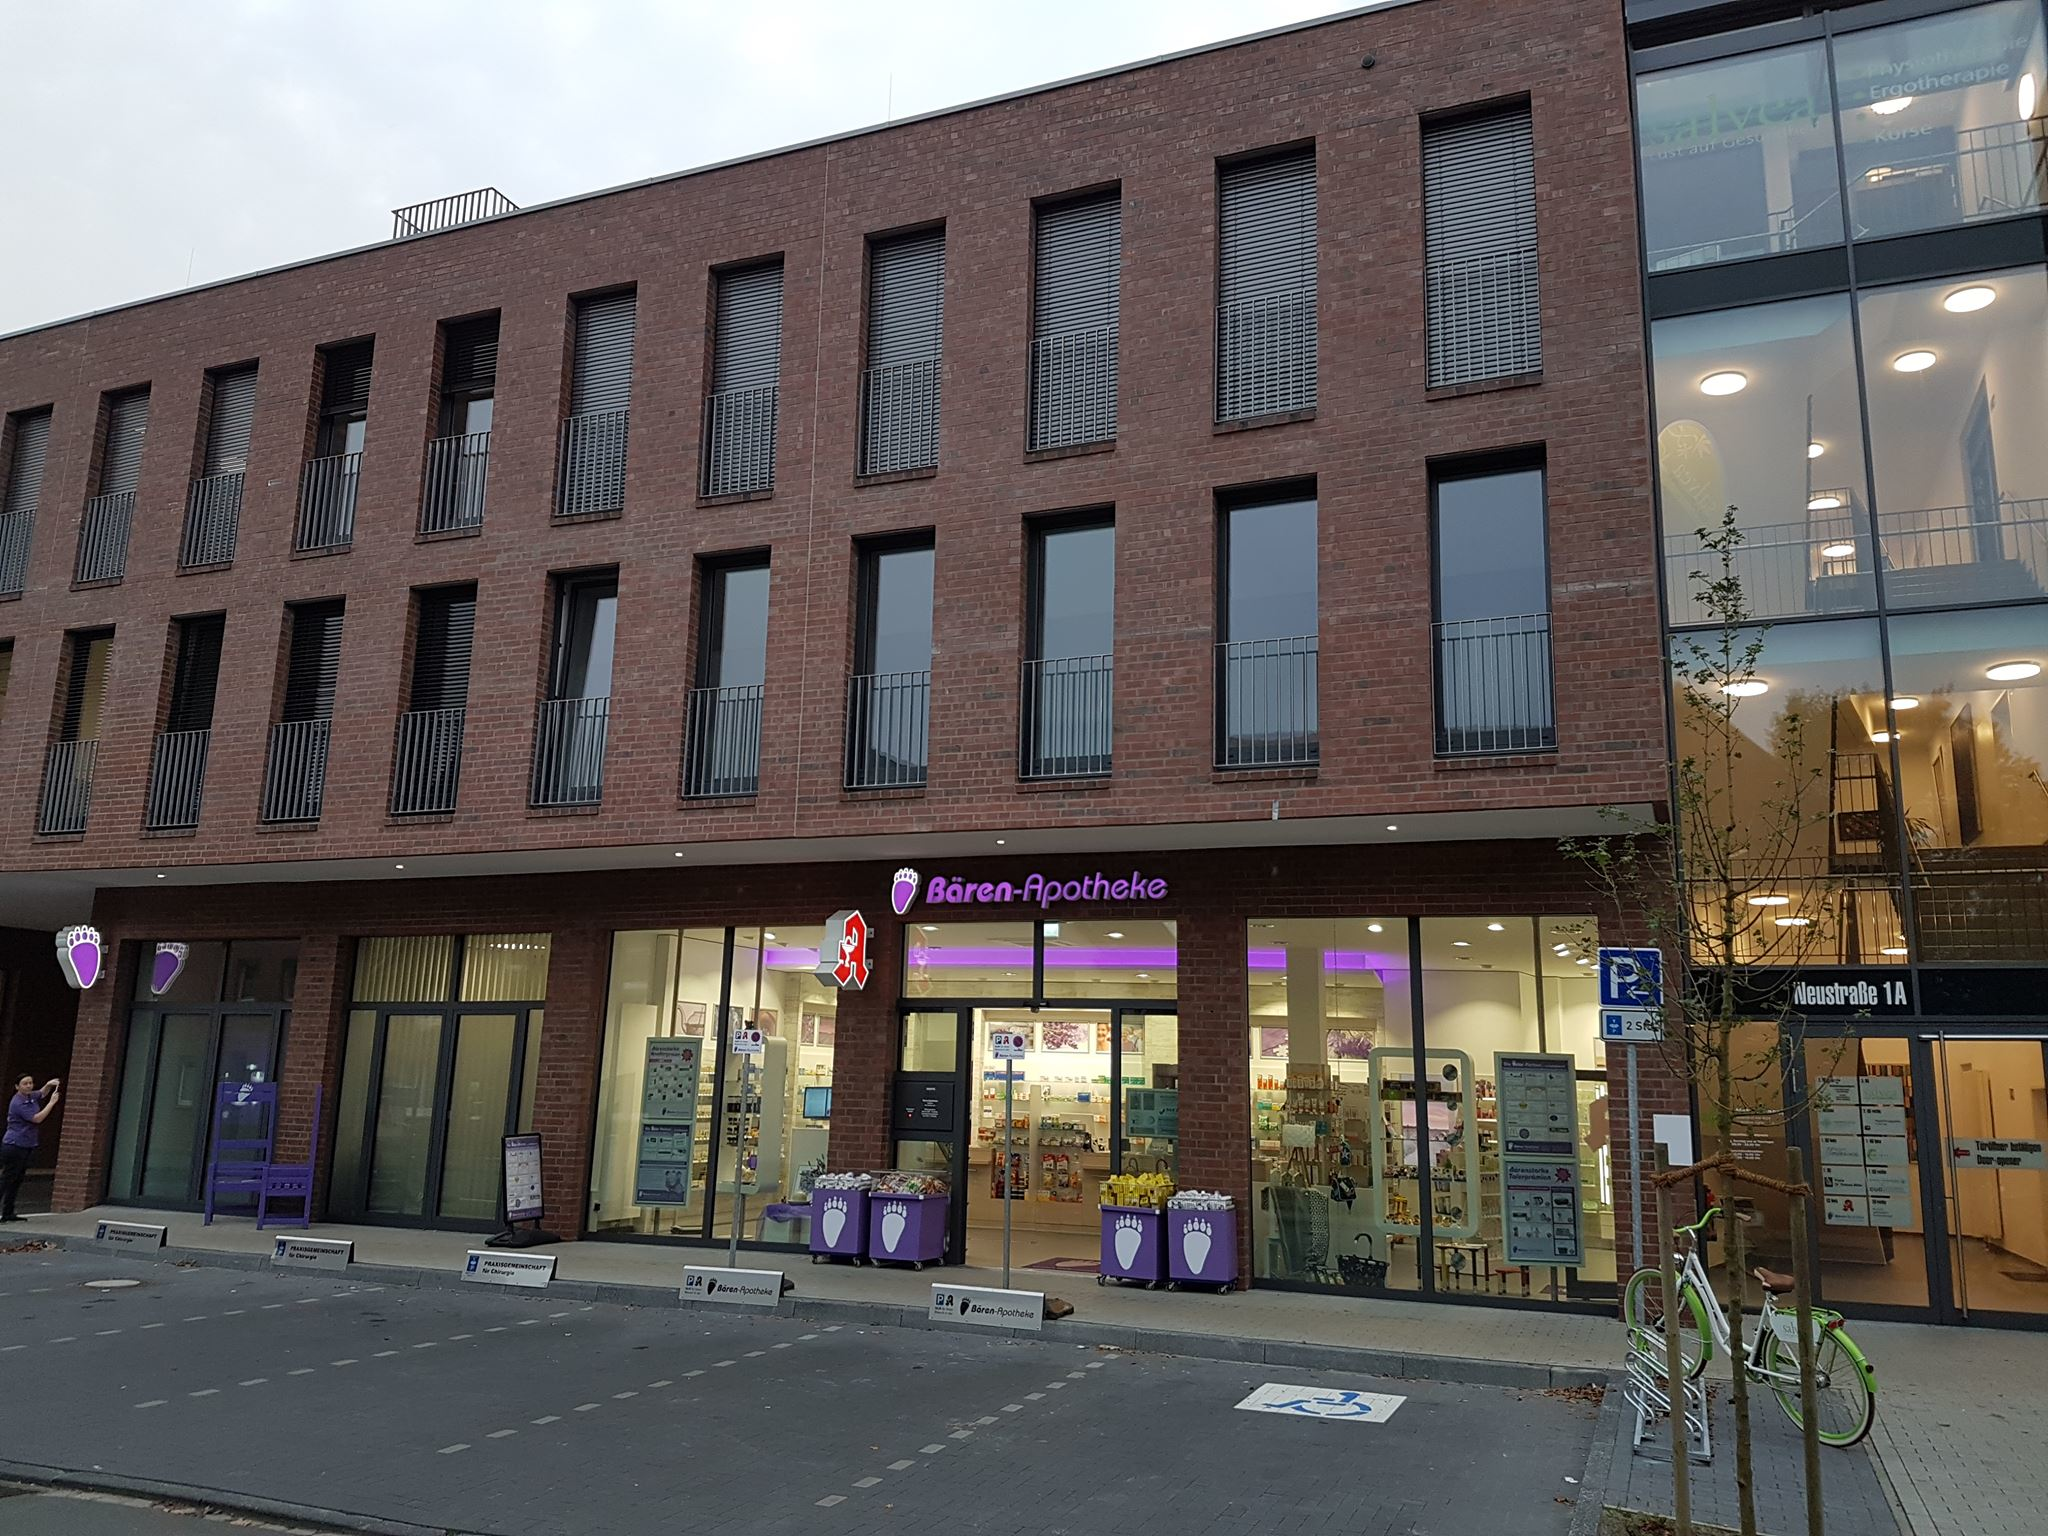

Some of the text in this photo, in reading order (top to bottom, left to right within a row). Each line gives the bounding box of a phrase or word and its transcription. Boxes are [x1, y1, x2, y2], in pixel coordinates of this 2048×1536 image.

[1868, 36, 2029, 79] Physiothie
[1870, 63, 2010, 100] Ergotherapie
[1874, 126, 1934, 143] Kurse
[926, 871, 1168, 909] Bären-Apotheke
[1610, 957, 1641, 998] P
[1794, 981, 1878, 1005] Neustraße
[1626, 1021, 1633, 1031] 2
[290, 1246, 344, 1255] PRAXISGEMEINSCHAFT
[484, 1261, 547, 1271] PRAXISGEMEINSCHAFT
[491, 1268, 514, 1276] Chirurgie
[717, 1284, 772, 1296] Bären-Apotheke
[971, 1304, 1034, 1318] Bären-Apotheke
